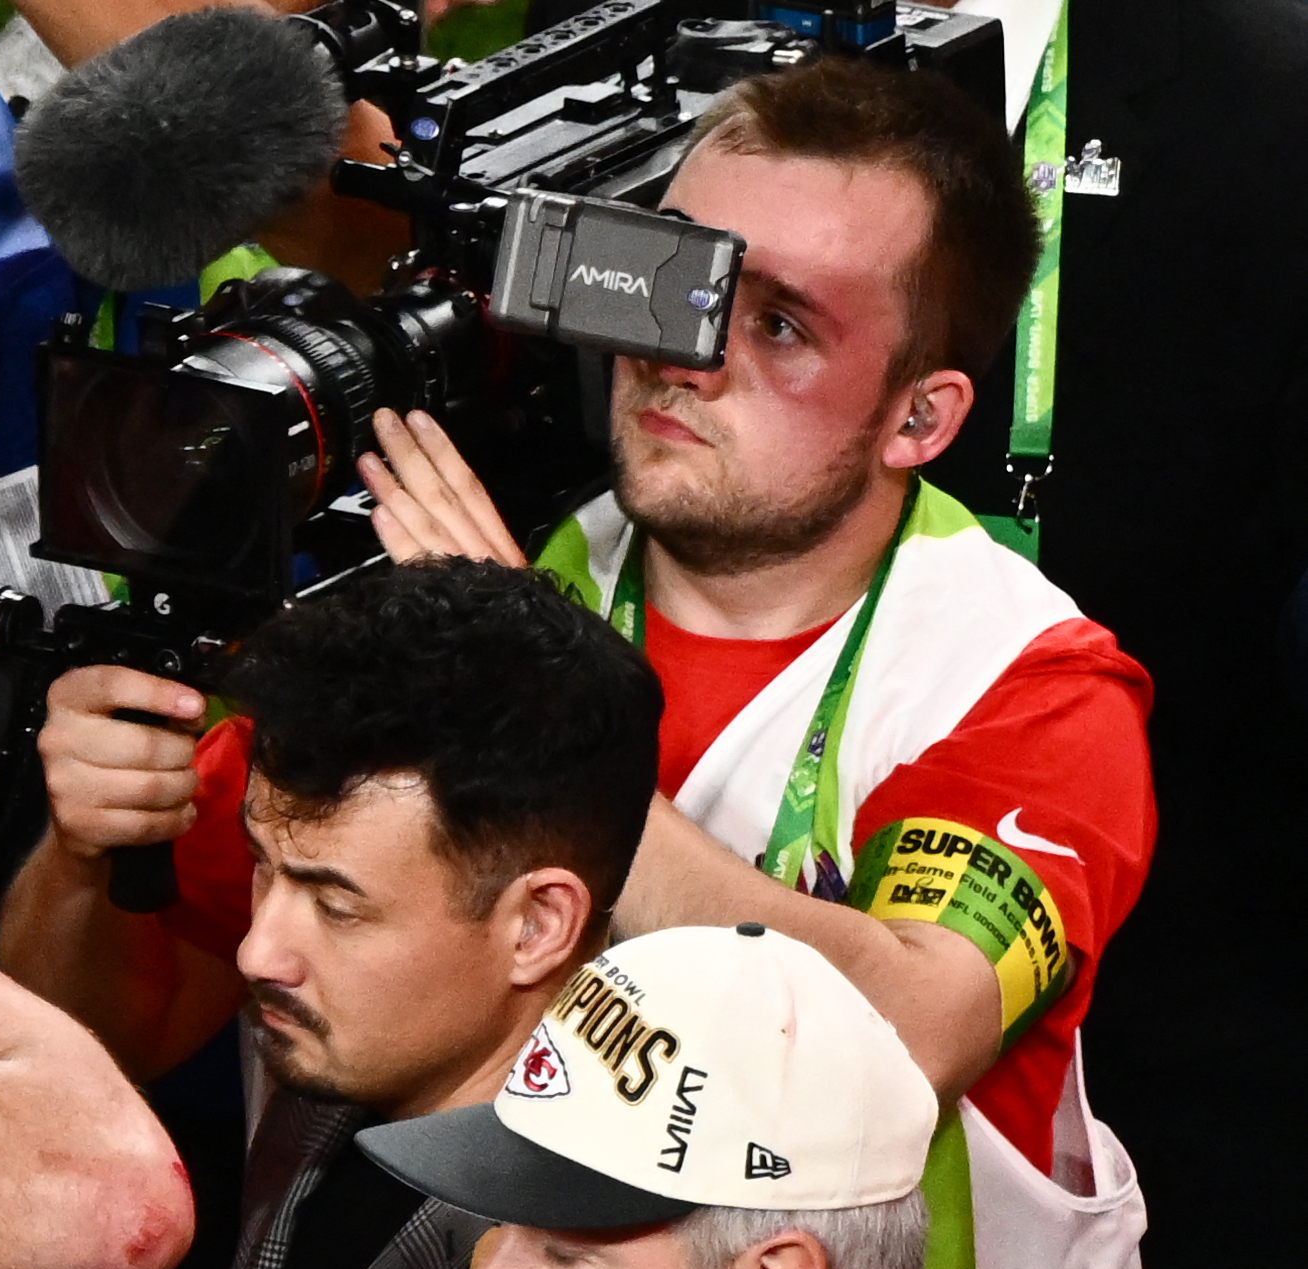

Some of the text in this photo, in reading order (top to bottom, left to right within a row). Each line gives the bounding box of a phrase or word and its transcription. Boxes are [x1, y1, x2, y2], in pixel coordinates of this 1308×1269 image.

[570, 264, 650, 298] AMIRA
[1028, 321, 1042, 368] BOWL
[1025, 374, 1040, 423] SUPER
[897, 829, 1061, 983] SUPER BOWL
[948, 898, 970, 915] NFL
[959, 873, 997, 903] Field
[997, 902, 1036, 958] Access
[604, 965, 647, 1007] BOWL
